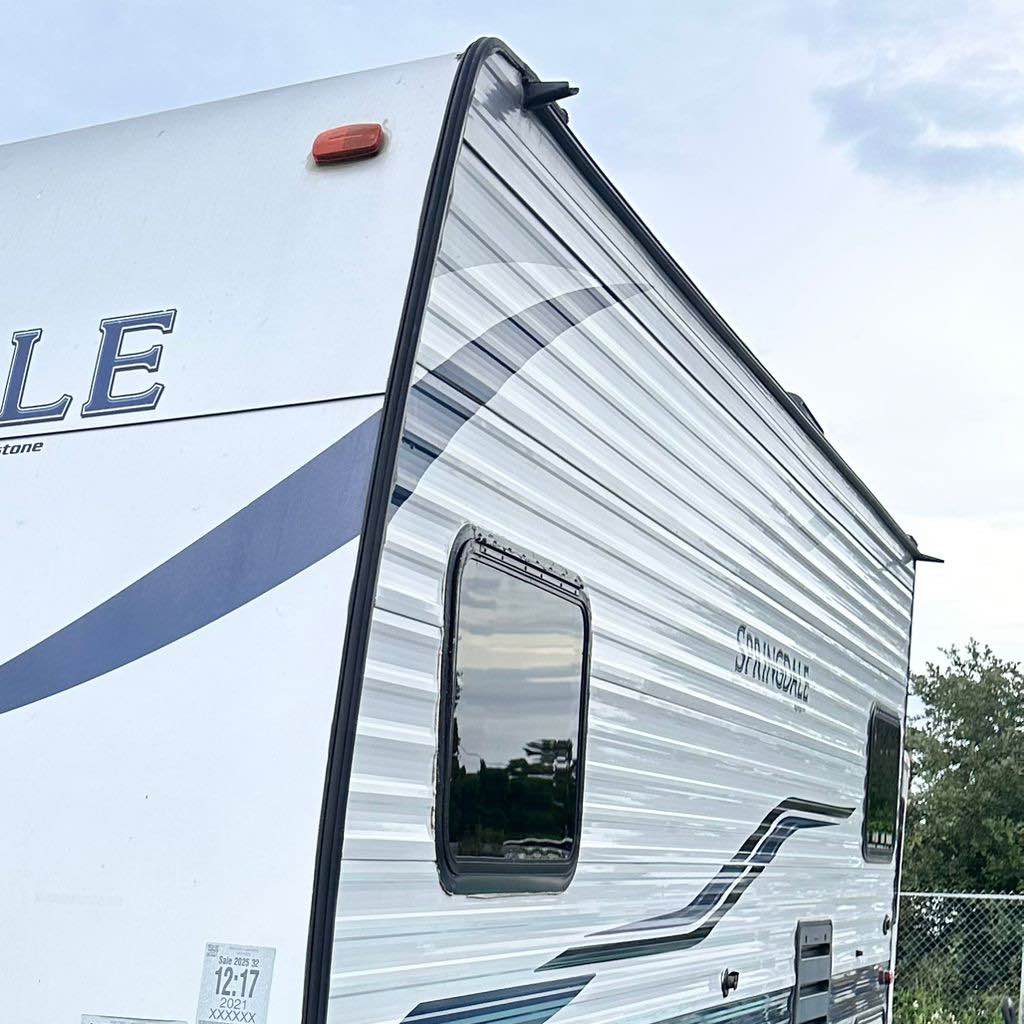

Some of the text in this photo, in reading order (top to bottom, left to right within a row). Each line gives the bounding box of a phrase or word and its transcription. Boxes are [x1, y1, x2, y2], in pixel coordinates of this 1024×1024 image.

[735, 625, 809, 702] SPRINGDALE
[218, 955, 233, 966] Sale
[215, 966, 260, 998] 12:17
[219, 997, 247, 1010] 2021
[208, 1008, 257, 1023] XXXXXX
